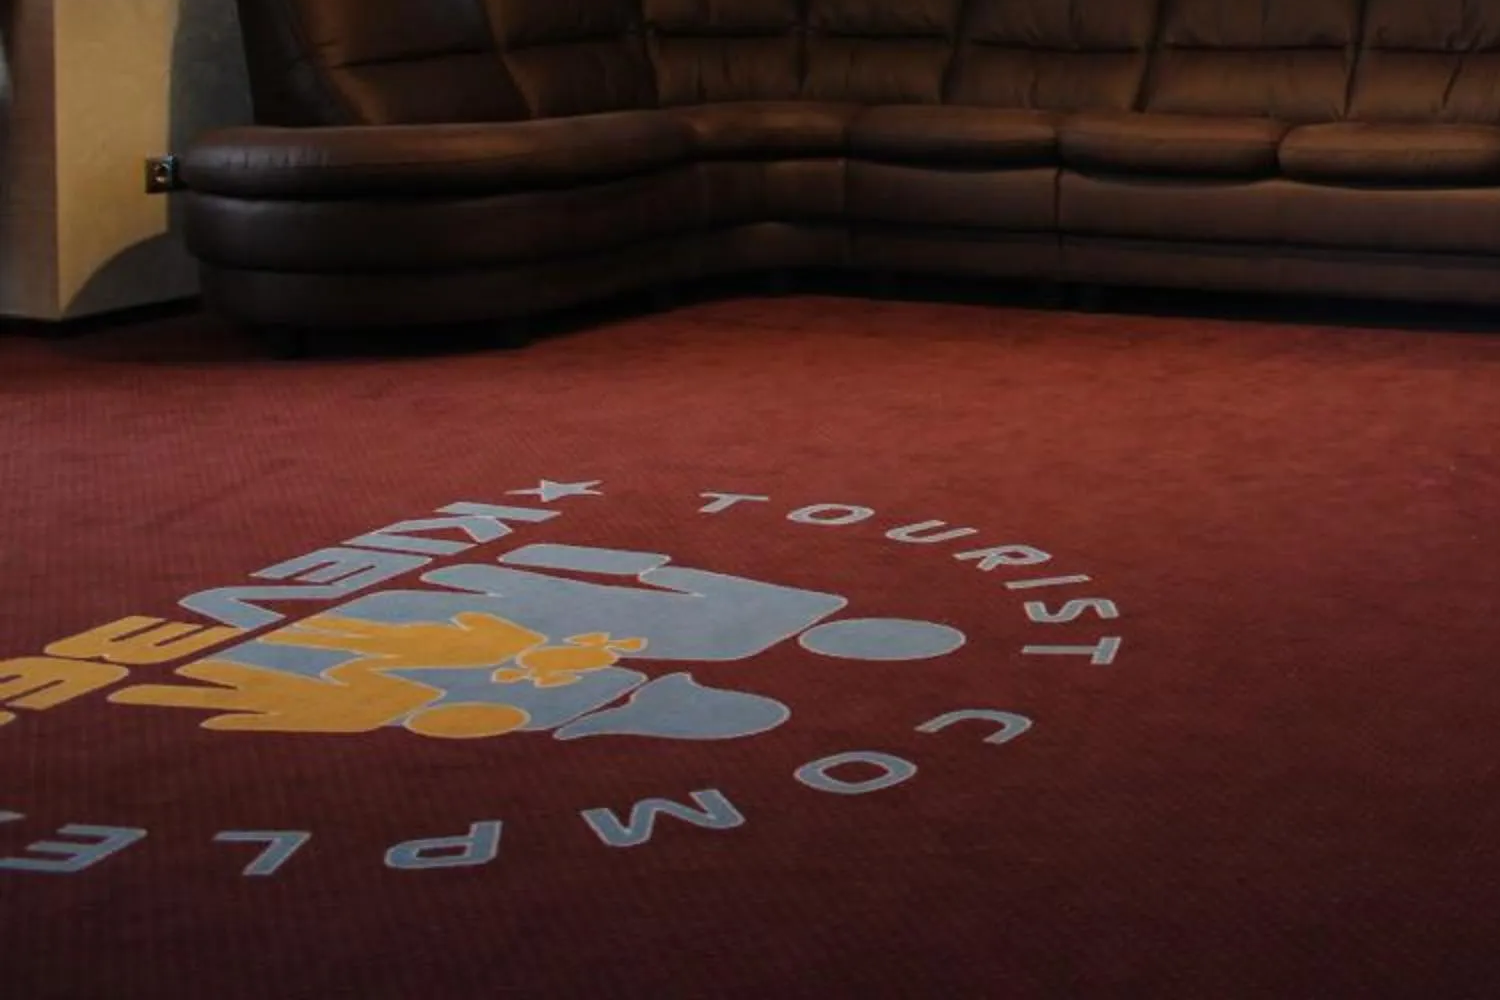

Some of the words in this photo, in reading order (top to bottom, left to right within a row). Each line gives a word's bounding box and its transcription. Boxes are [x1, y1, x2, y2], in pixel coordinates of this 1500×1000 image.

[0, 501, 562, 727] KIEV36
[699, 492, 1121, 665] TOURIST
[0, 709, 1033, 876] COMPLE
